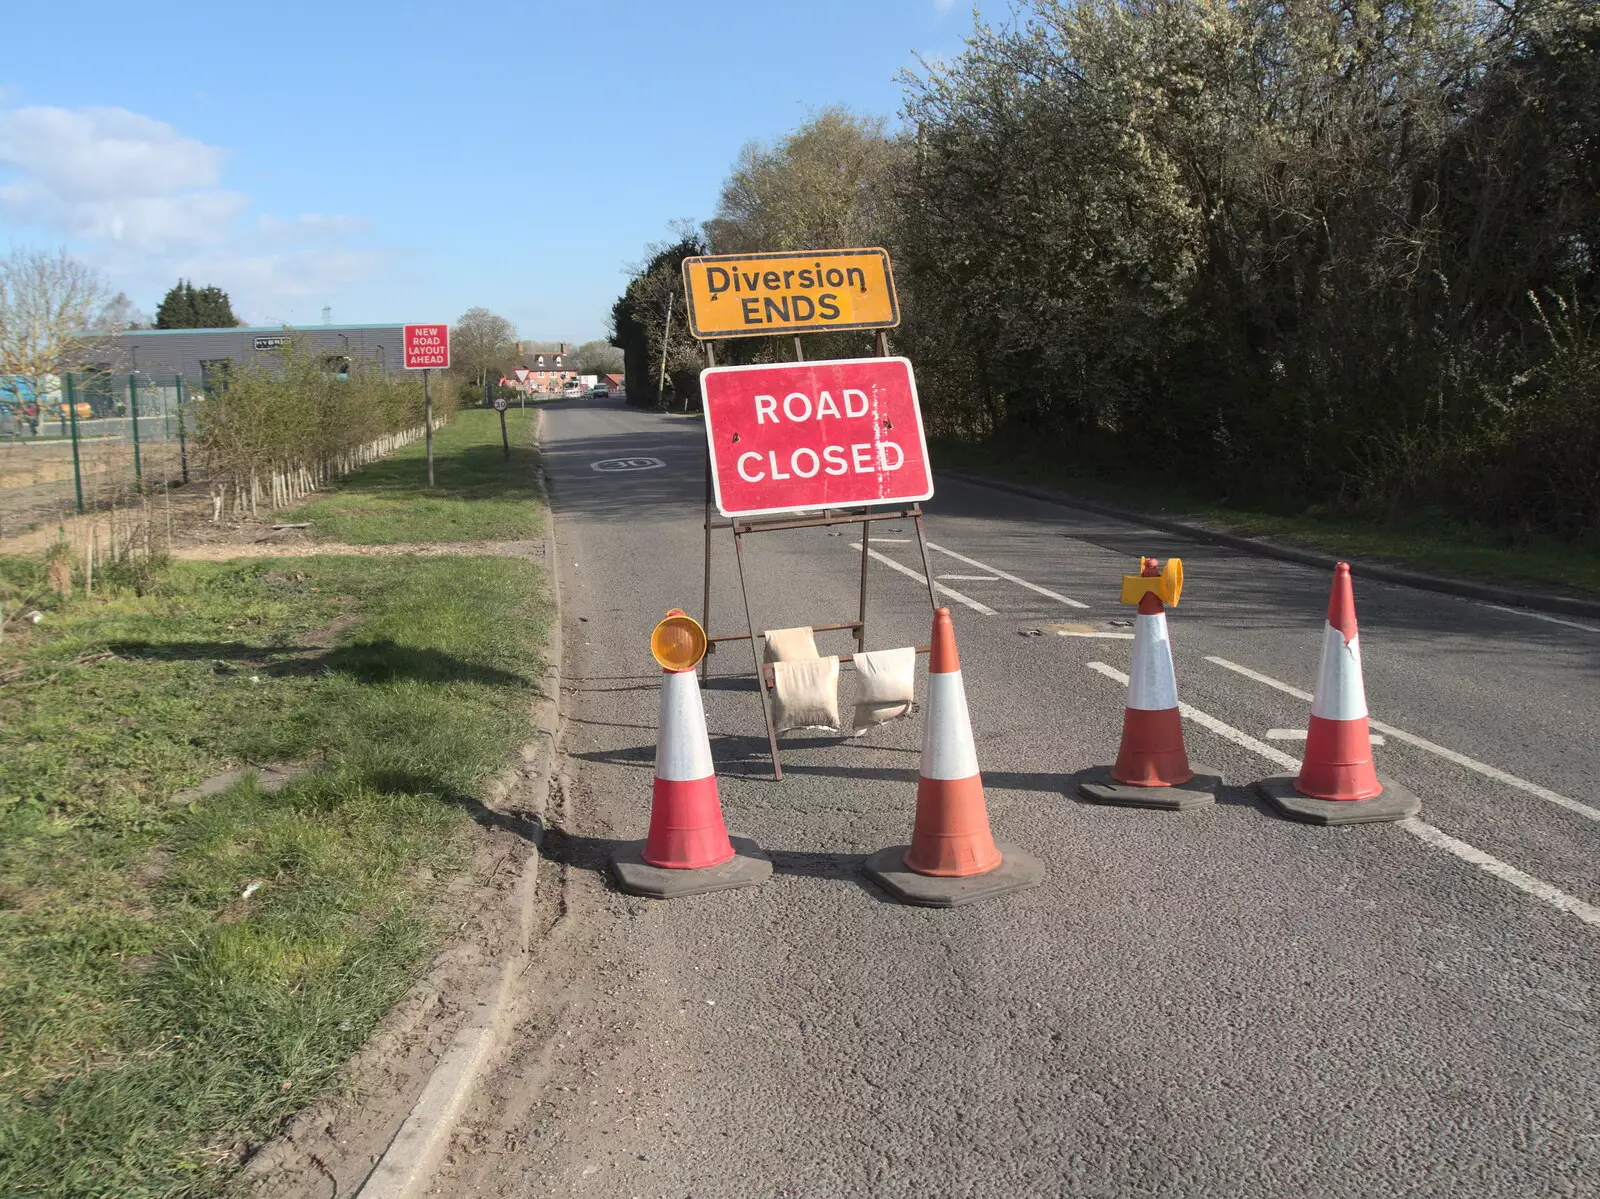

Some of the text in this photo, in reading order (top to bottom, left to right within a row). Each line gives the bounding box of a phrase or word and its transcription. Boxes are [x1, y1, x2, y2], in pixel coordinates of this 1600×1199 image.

[706, 262, 866, 292] Diversion
[741, 293, 841, 325] ENDS
[413, 337, 440, 345] ROAD
[415, 328, 438, 336] NEW
[408, 346, 446, 355] LAYOUT
[410, 355, 444, 364] AHEAD
[754, 389, 870, 425] ROAD
[737, 441, 904, 483] CLOSED
